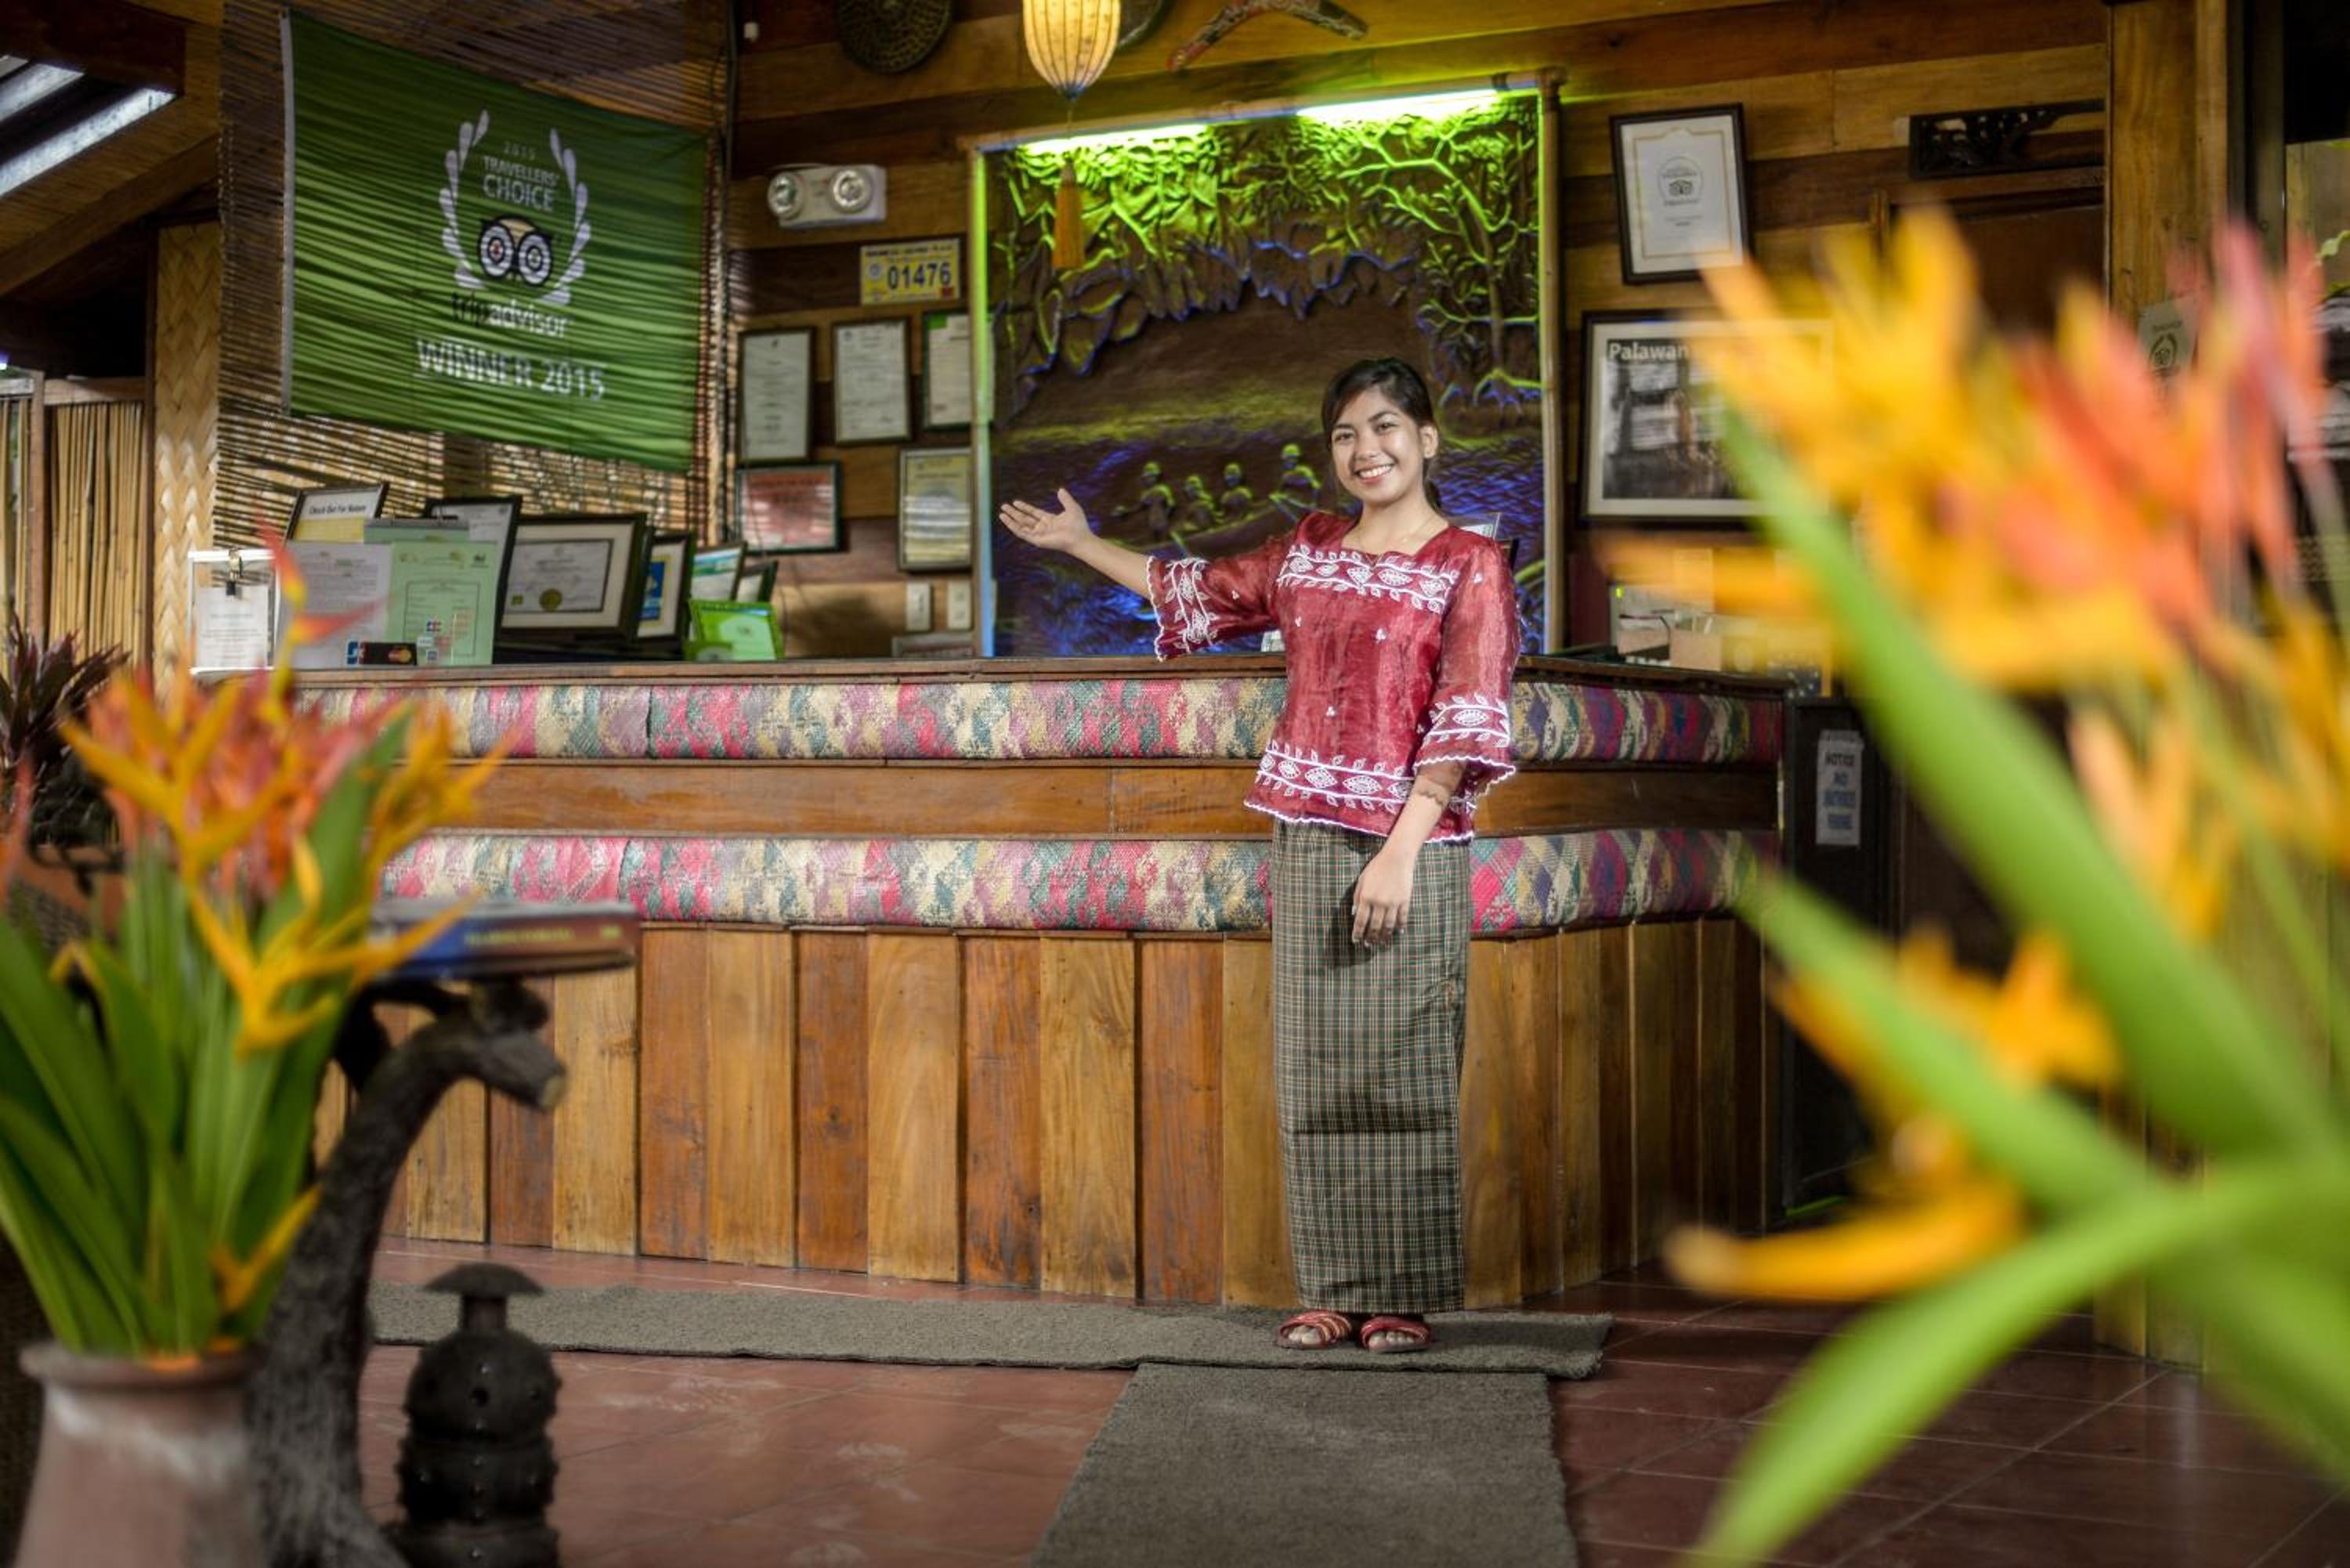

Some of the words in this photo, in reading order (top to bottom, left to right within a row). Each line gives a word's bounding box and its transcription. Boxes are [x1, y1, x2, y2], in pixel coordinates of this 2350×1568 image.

[483, 174, 552, 212] CHOICE
[888, 260, 951, 290] 01476
[451, 291, 567, 338] tripadvisor
[1609, 341, 1690, 361] Palawan
[417, 340, 533, 387] WINNER
[540, 361, 605, 402] 2015
